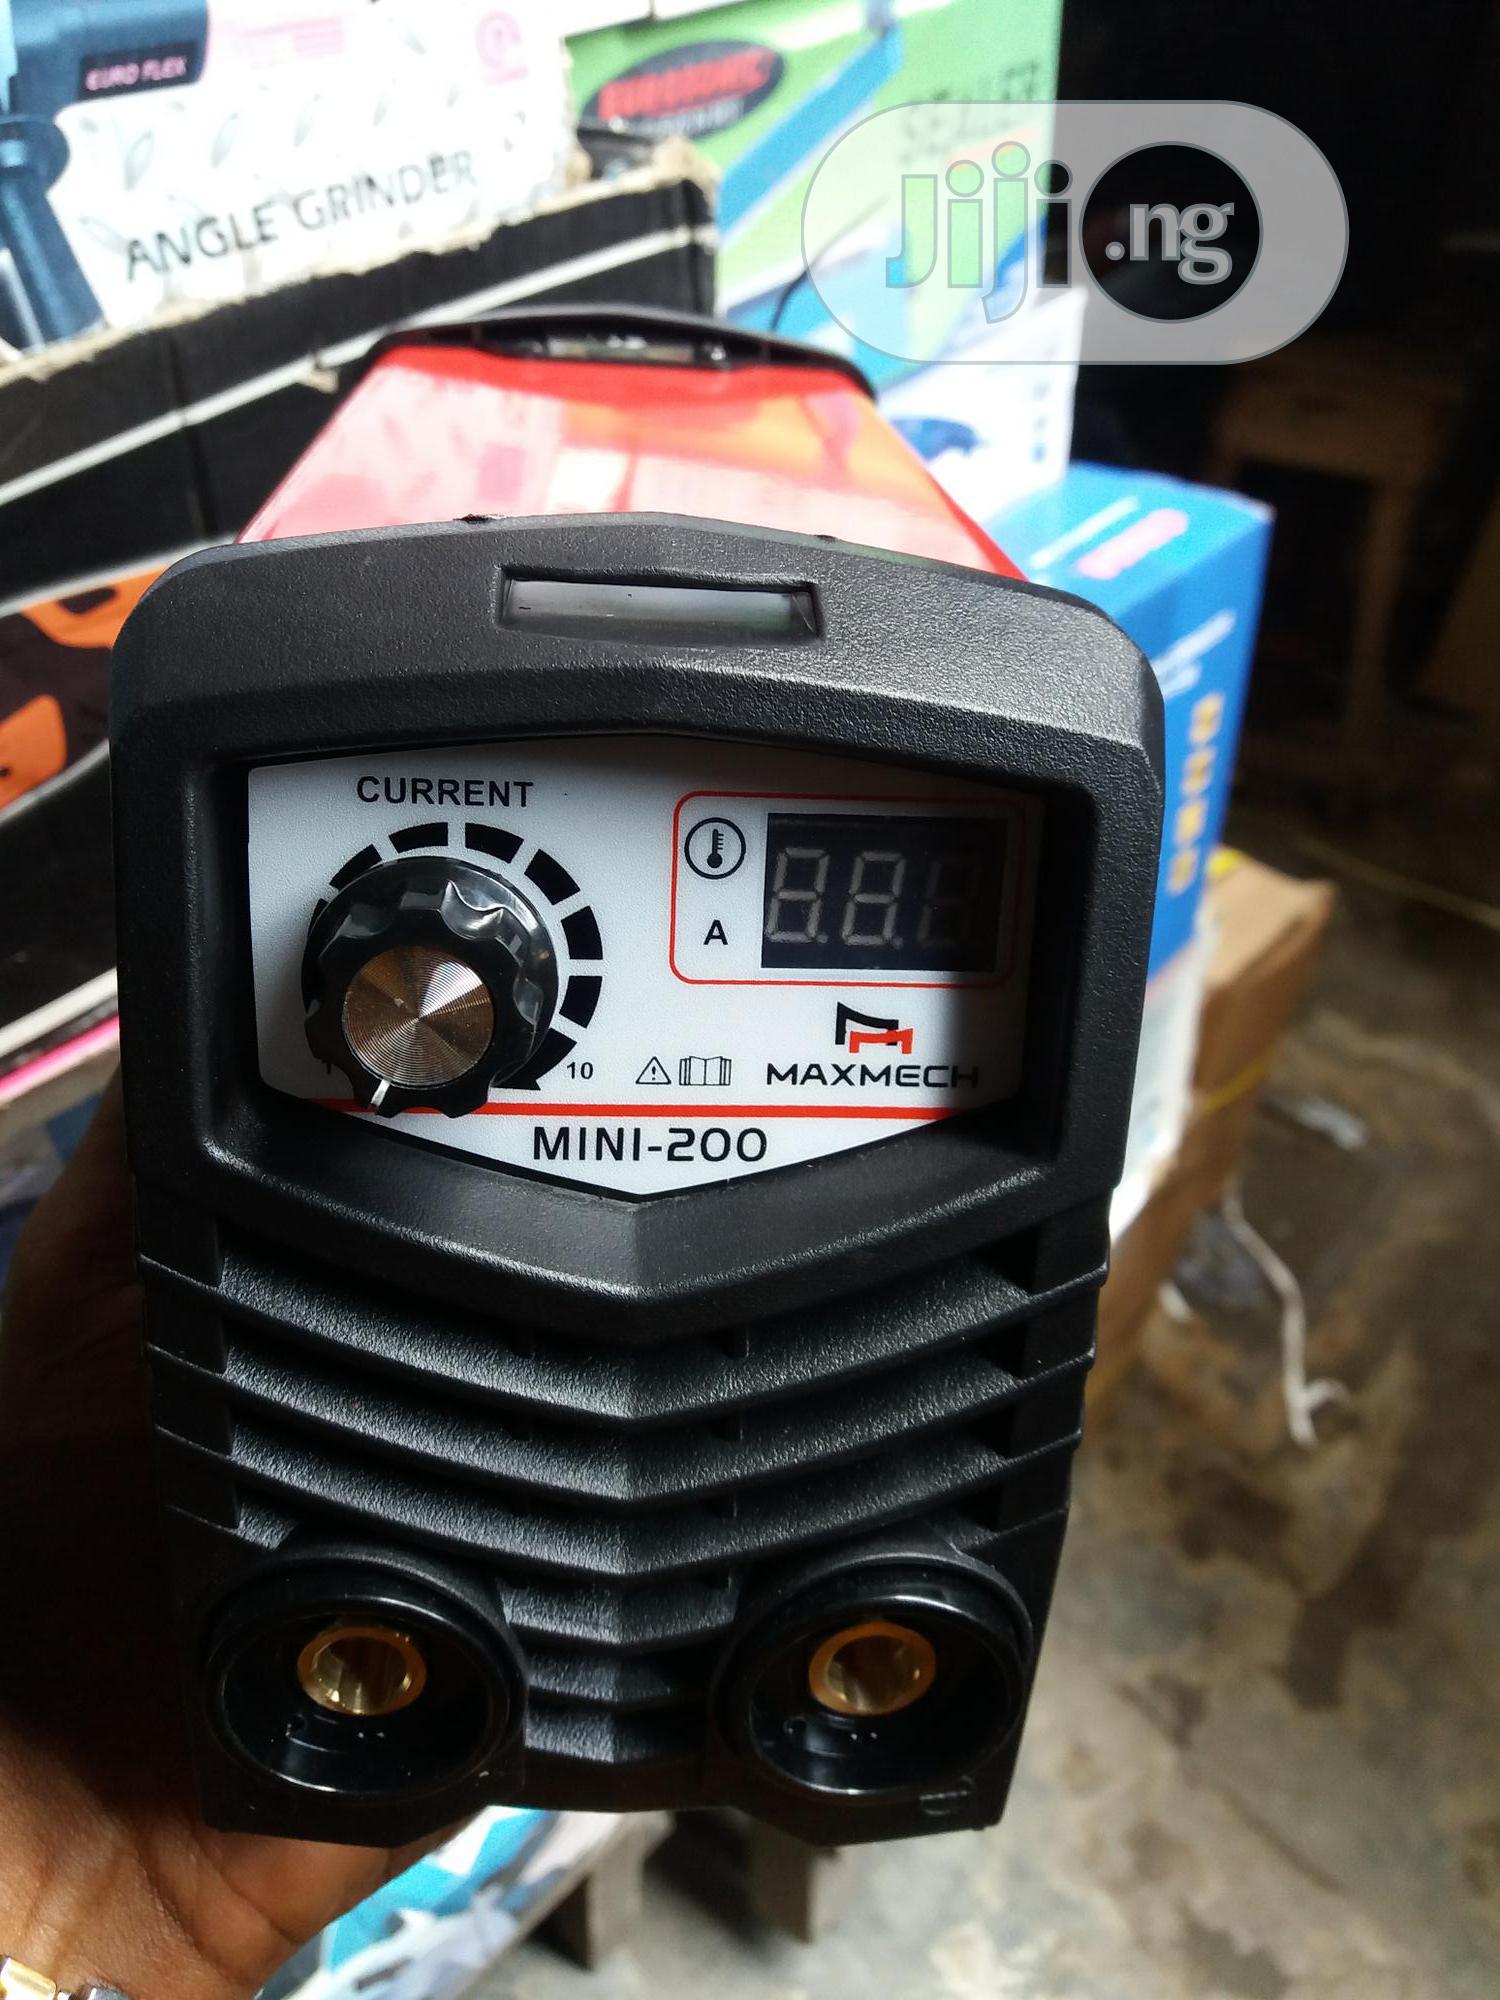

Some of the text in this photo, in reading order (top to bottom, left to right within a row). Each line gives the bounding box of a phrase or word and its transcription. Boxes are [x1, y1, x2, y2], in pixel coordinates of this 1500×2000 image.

[85, 62, 140, 91] EURO
[126, 150, 477, 282] ANGLE GRINDER
[357, 775, 534, 808] CURRENT
[703, 919, 729, 946] A
[566, 1061, 594, 1080] 10
[766, 1062, 980, 1089] MAXMECH
[533, 1126, 768, 1163] MINI-200
